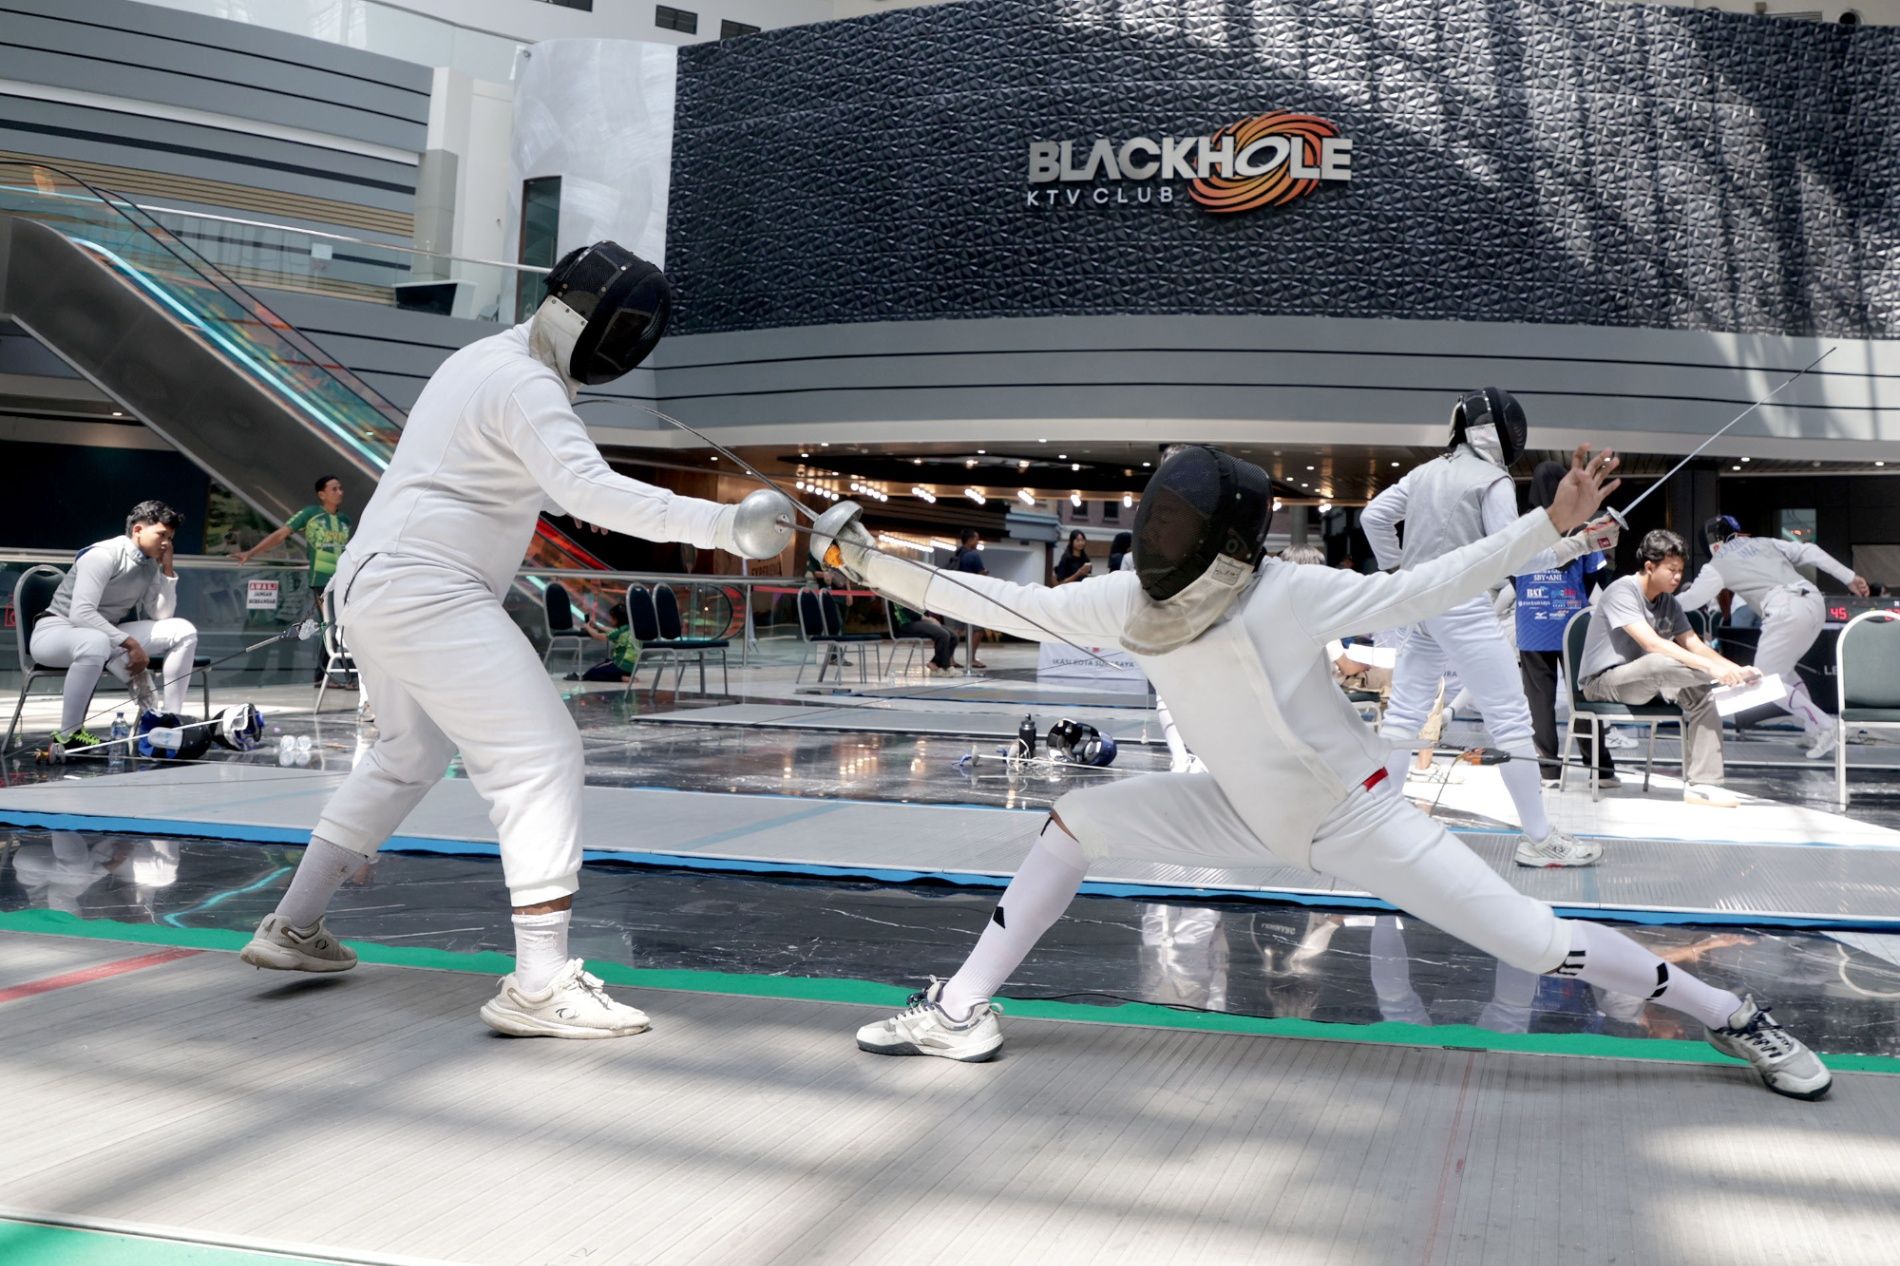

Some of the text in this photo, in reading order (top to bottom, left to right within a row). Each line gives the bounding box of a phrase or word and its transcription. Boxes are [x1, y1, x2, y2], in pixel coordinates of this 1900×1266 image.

[1028, 135, 1353, 183] BLACKHOLE
[1027, 186, 1173, 206] KTV CLUB
[1829, 607, 1849, 620] 45
